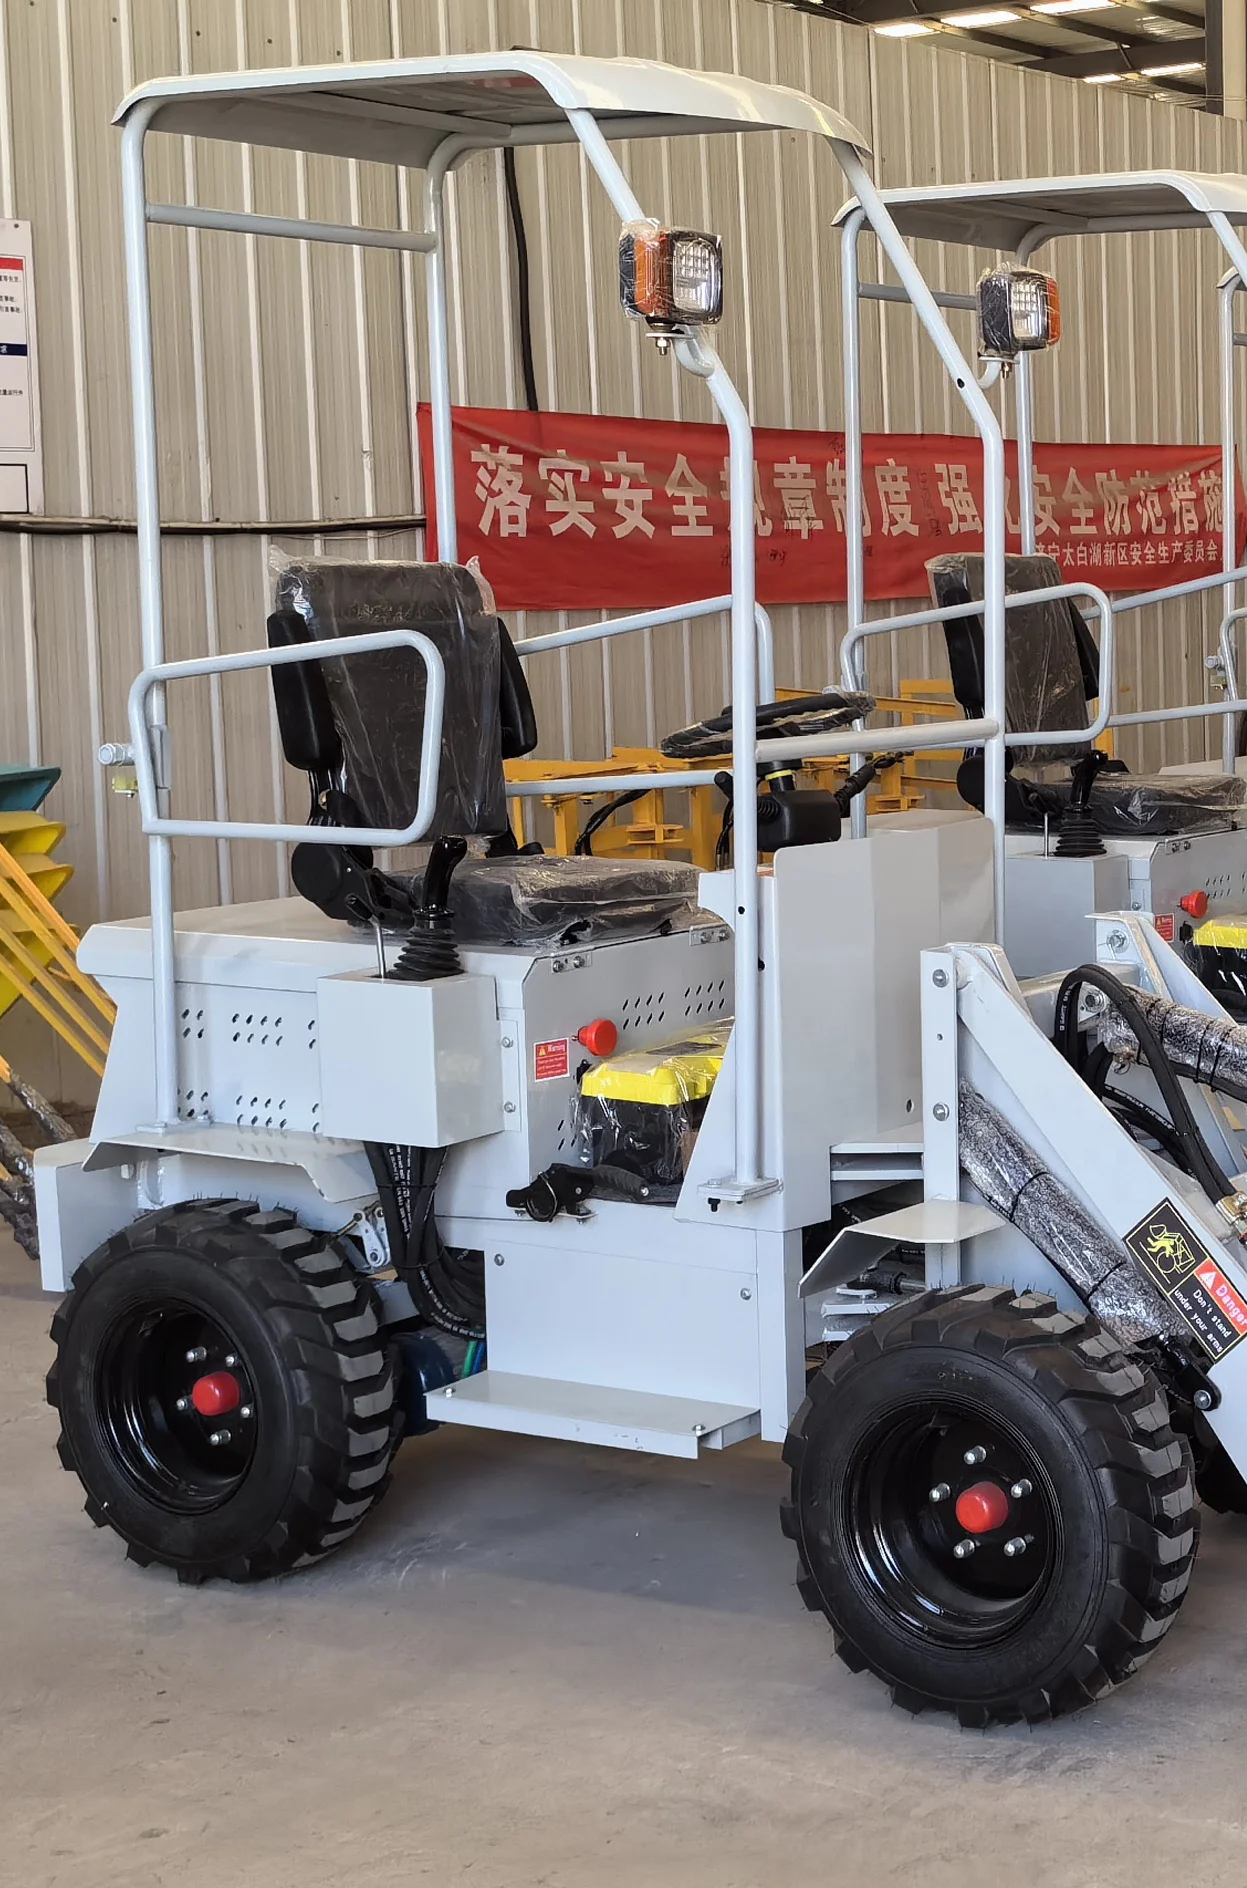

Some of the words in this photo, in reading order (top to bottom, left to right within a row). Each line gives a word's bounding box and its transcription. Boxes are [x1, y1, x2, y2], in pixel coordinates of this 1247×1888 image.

[1035, 539, 1224, 567] 宁太白湖新区安全生产委员会
[1174, 1289, 1193, 1312] under
[1190, 1312, 1208, 1331] your
[1206, 1332, 1224, 1353] arms
[1193, 1288, 1213, 1315] Don't
[1211, 1314, 1232, 1338] stand
